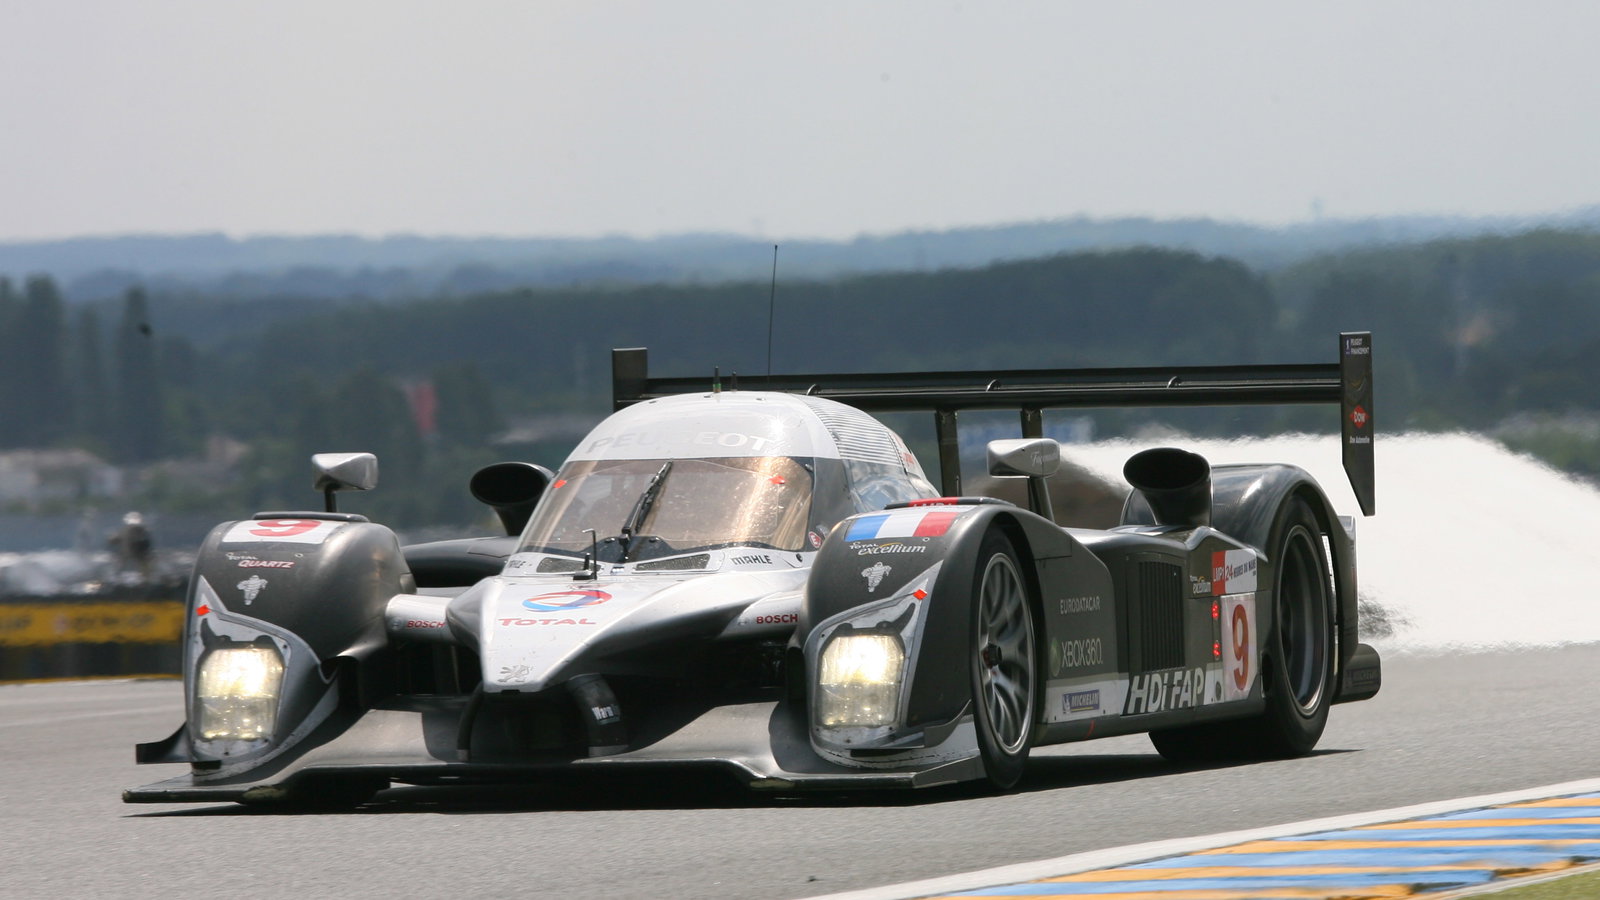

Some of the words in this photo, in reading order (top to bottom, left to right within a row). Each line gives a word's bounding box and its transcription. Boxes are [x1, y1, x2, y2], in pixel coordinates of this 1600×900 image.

[249, 519, 322, 537] 9
[857, 542, 927, 557] excellium
[238, 559, 295, 569] QUARTZ
[731, 555, 773, 566] MAHLE
[1060, 596, 1101, 614] EURODATACAR
[407, 620, 446, 629] BOSCH
[498, 618, 597, 627] TOTAL
[756, 613, 799, 625] BOSCH
[1232, 604, 1249, 691] 9
[1127, 672, 1169, 714] HDi
[1169, 667, 1205, 710] FAP
[1071, 692, 1099, 708] MICHELIN
